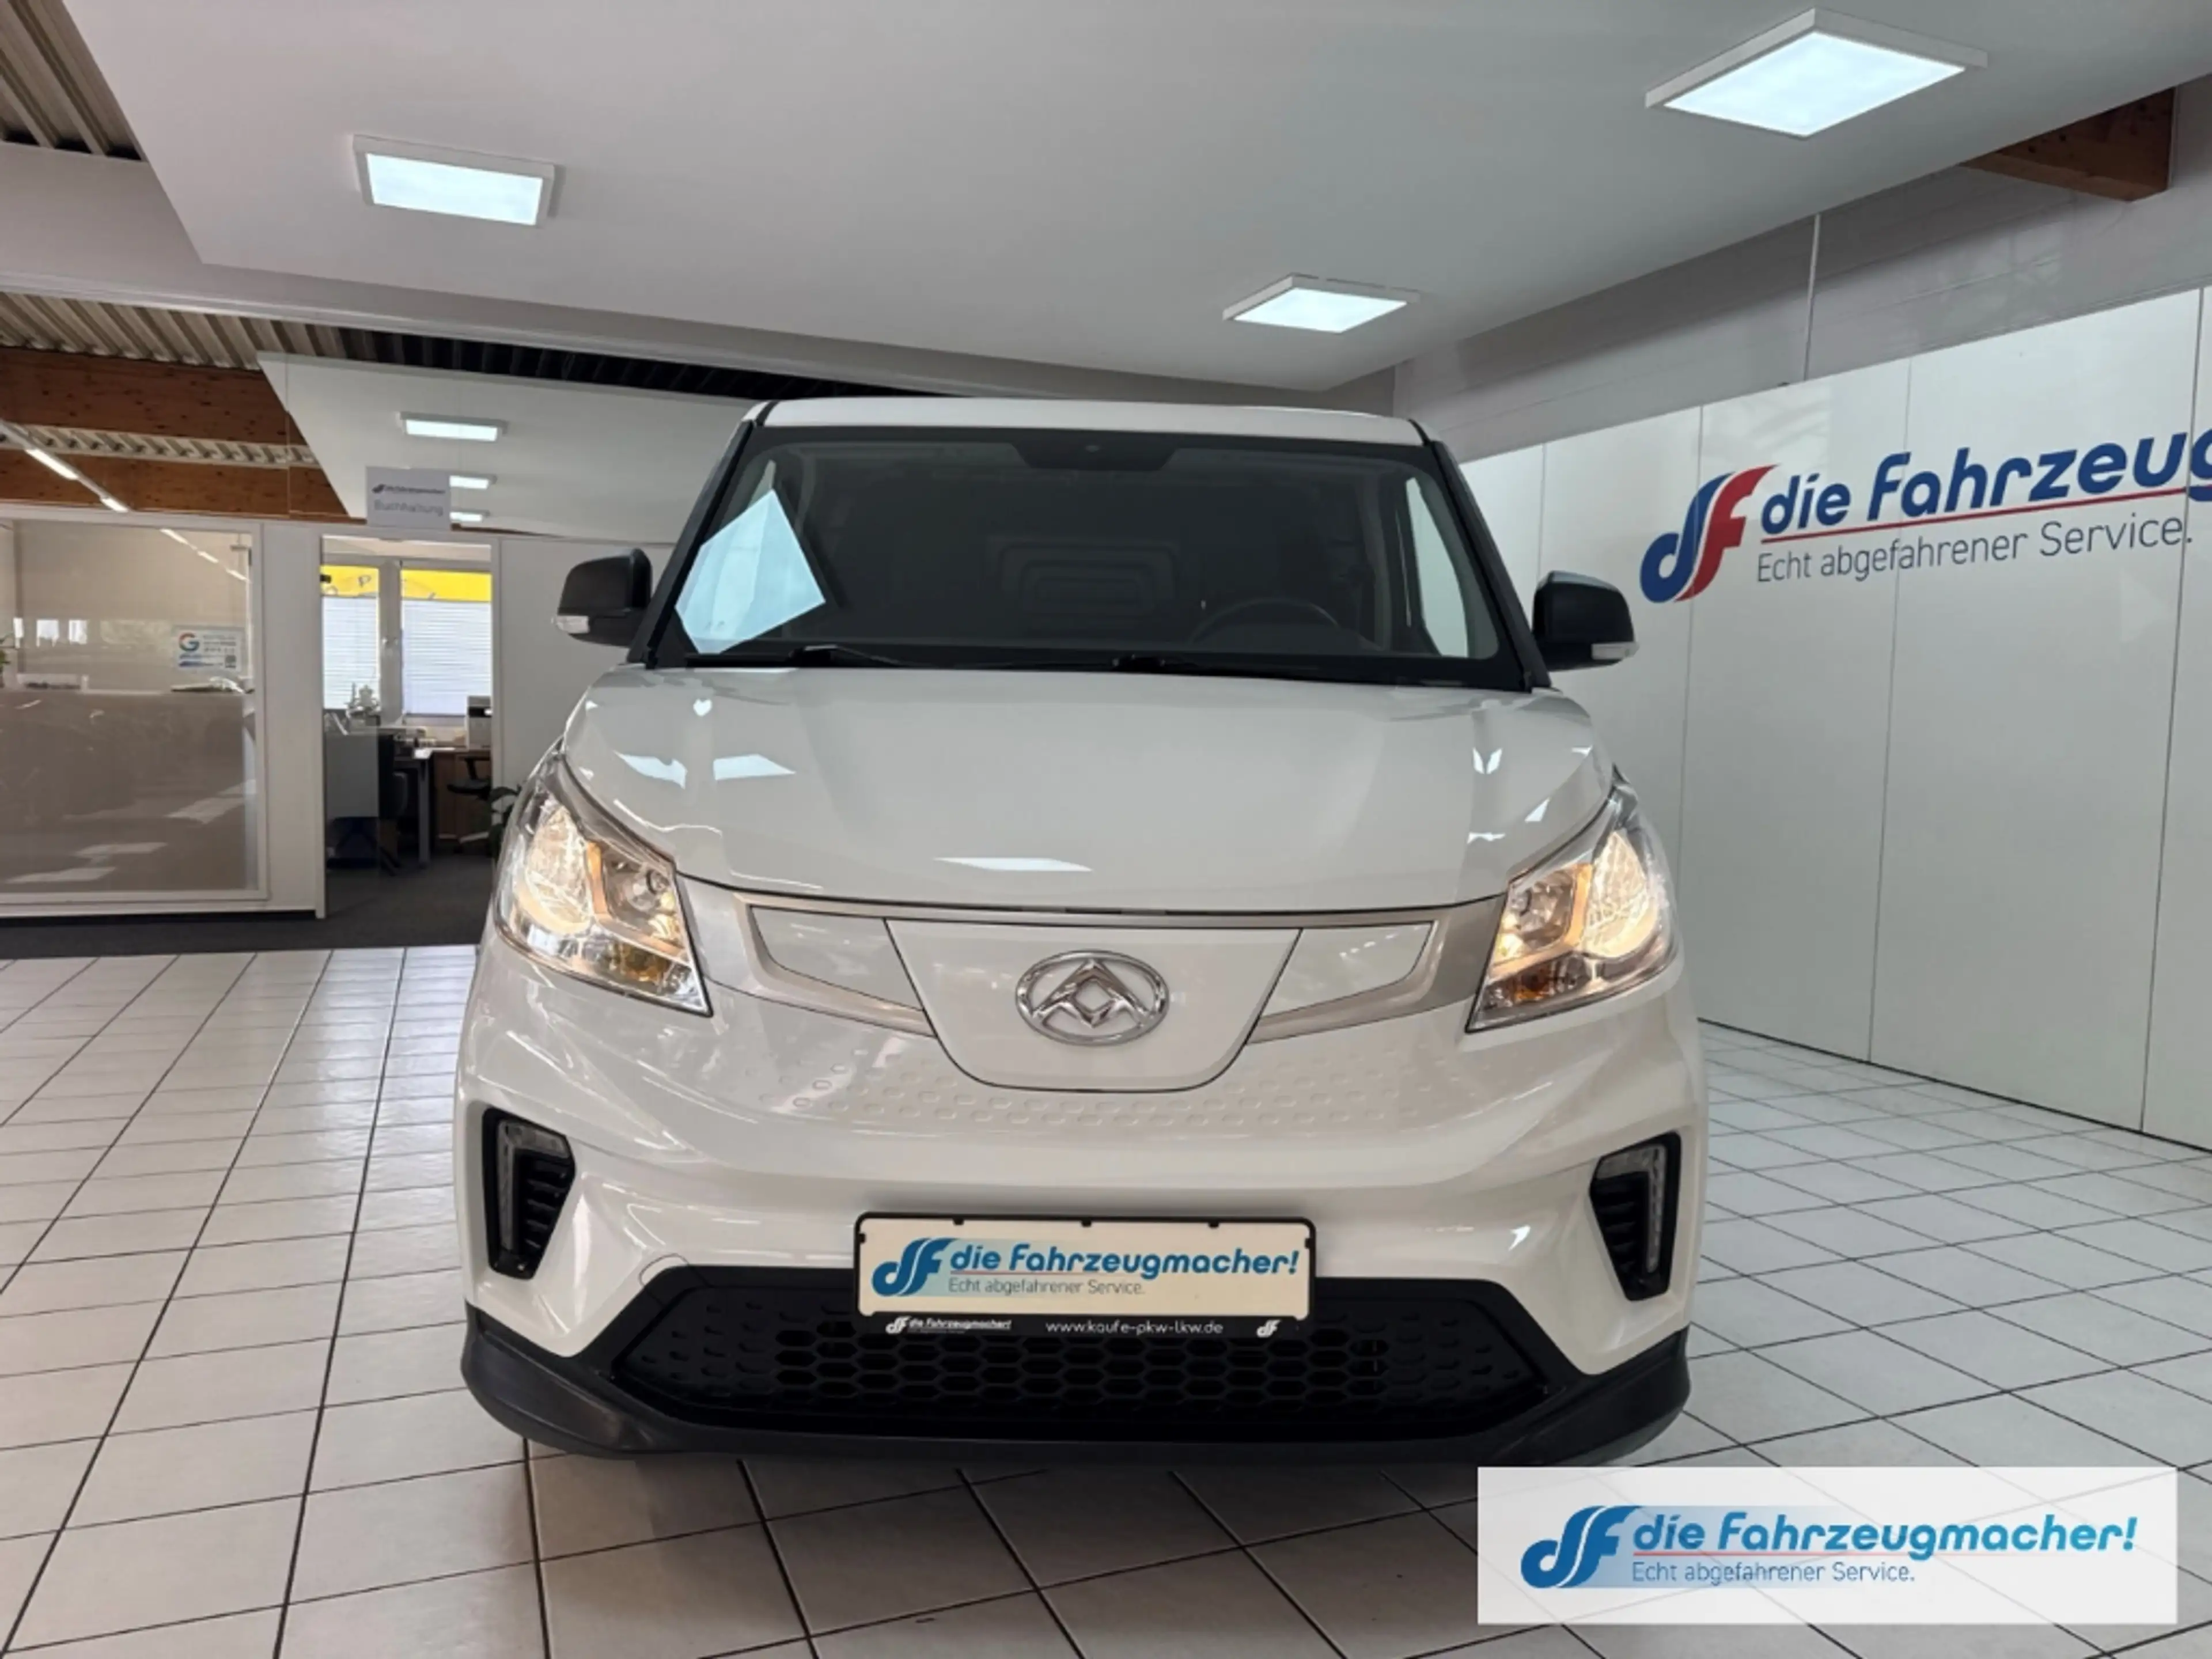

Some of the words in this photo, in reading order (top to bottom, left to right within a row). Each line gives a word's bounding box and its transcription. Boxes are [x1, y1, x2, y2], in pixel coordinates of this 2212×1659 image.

[1760, 472, 1851, 535] die
[1757, 551, 1812, 583] Echt
[1820, 529, 2028, 582] abgefahrener
[2040, 513, 2192, 558] Service.
[950, 1244, 1002, 1271] die
[1009, 1243, 1299, 1281] Fahrzeugmacher!
[948, 1277, 980, 1293] Echt
[984, 1278, 1083, 1297] abgefahrener
[1046, 1320, 1224, 1335] www.kaufe-pkw-lkw.de
